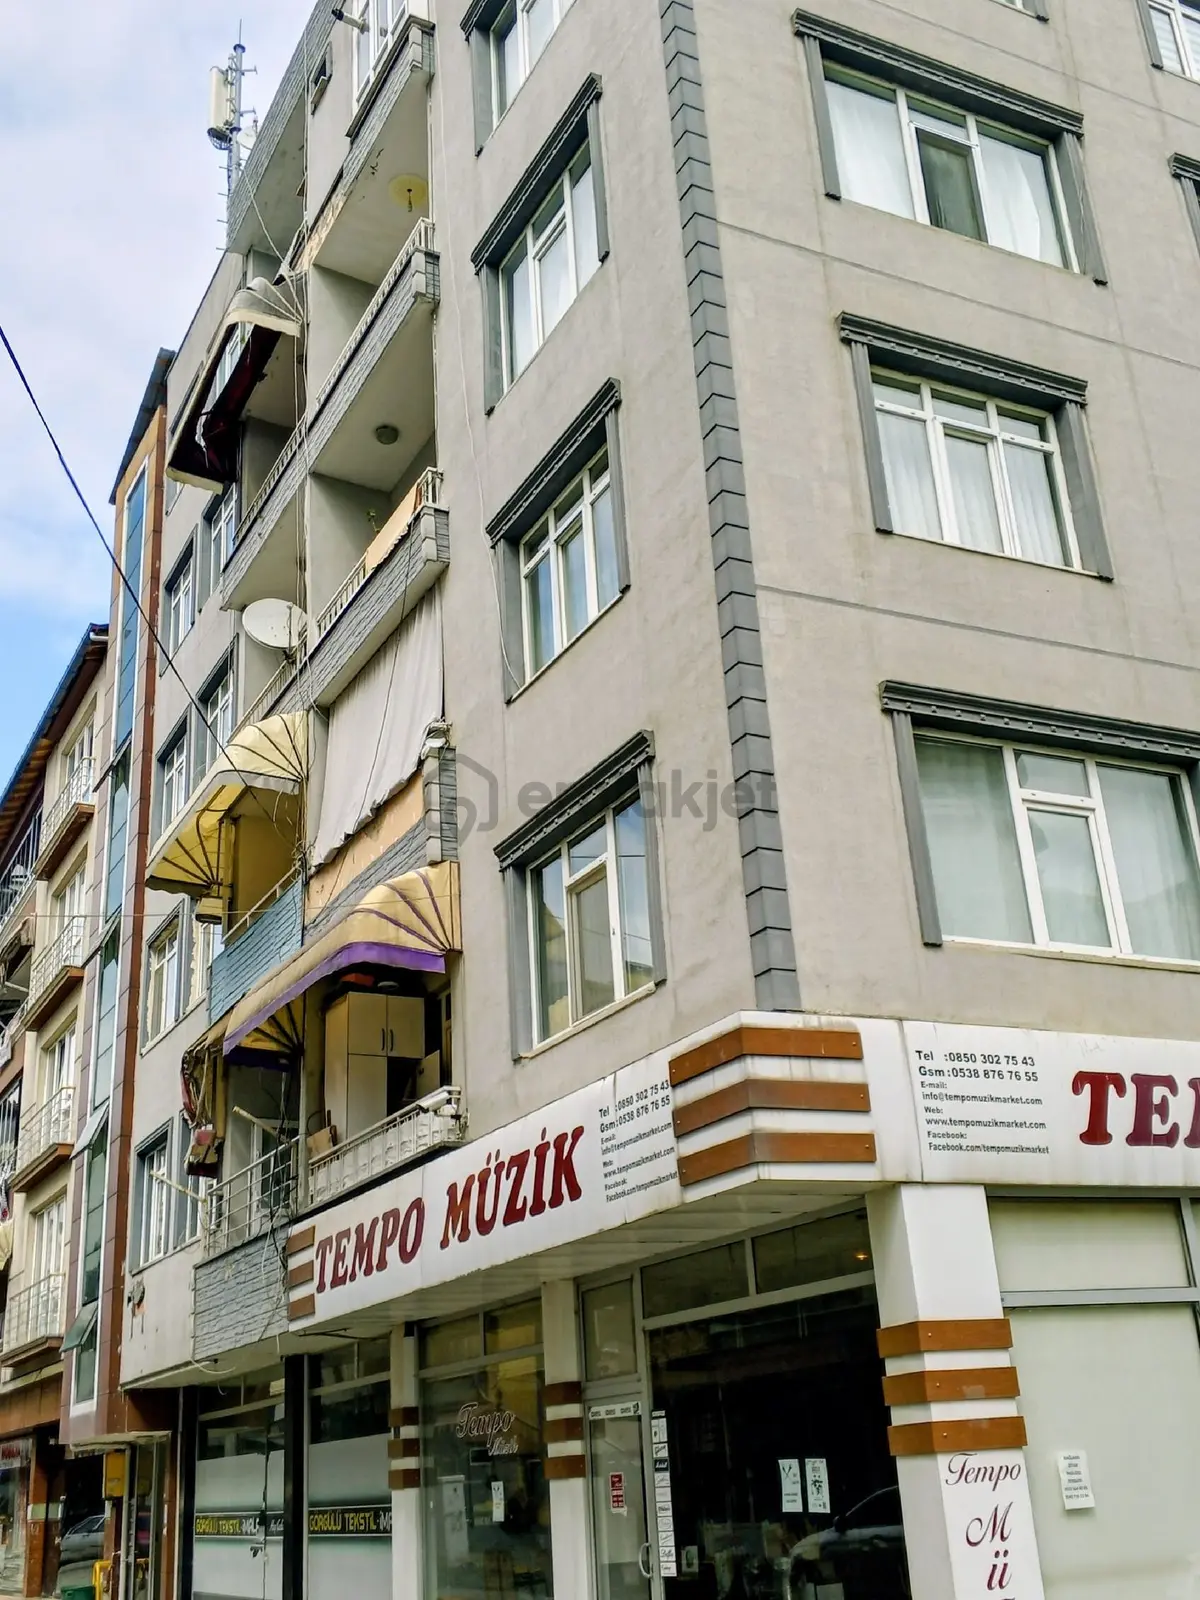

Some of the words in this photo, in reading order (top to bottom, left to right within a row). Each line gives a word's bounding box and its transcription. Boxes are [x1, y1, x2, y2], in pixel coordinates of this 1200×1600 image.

[915, 1050, 934, 1061] Tel
[980, 1054, 1001, 1065] 302
[1004, 1055, 1018, 1066] 75
[1021, 1056, 1035, 1067] 43
[983, 1069, 1004, 1080] 876
[1007, 1070, 1022, 1081] 76
[1024, 1071, 1038, 1082] 55
[920, 1081, 947, 1089] E-mail:
[598, 1106, 610, 1119] Tel
[635, 1088, 648, 1103] 302
[650, 1083, 659, 1096] 75
[660, 1079, 669, 1092] 43
[921, 1091, 1043, 1105] info@tempomuzikmarket.com
[636, 1103, 649, 1119] 876
[650, 1099, 660, 1112] 76
[661, 1094, 671, 1107] 55
[923, 1106, 943, 1114] Web:
[1071, 1070, 1200, 1149] TE
[925, 1117, 1047, 1129] www.tempomuzikmarket.com
[927, 1131, 967, 1139] Facebook:
[928, 1142, 1050, 1155] Facebook.com/tempomuzikmarket
[315, 1197, 425, 1294] TEMPO
[440, 1125, 585, 1250] MÜZİK
[456, 1402, 516, 1447] Tempo
[945, 1452, 1021, 1492] Tempo
